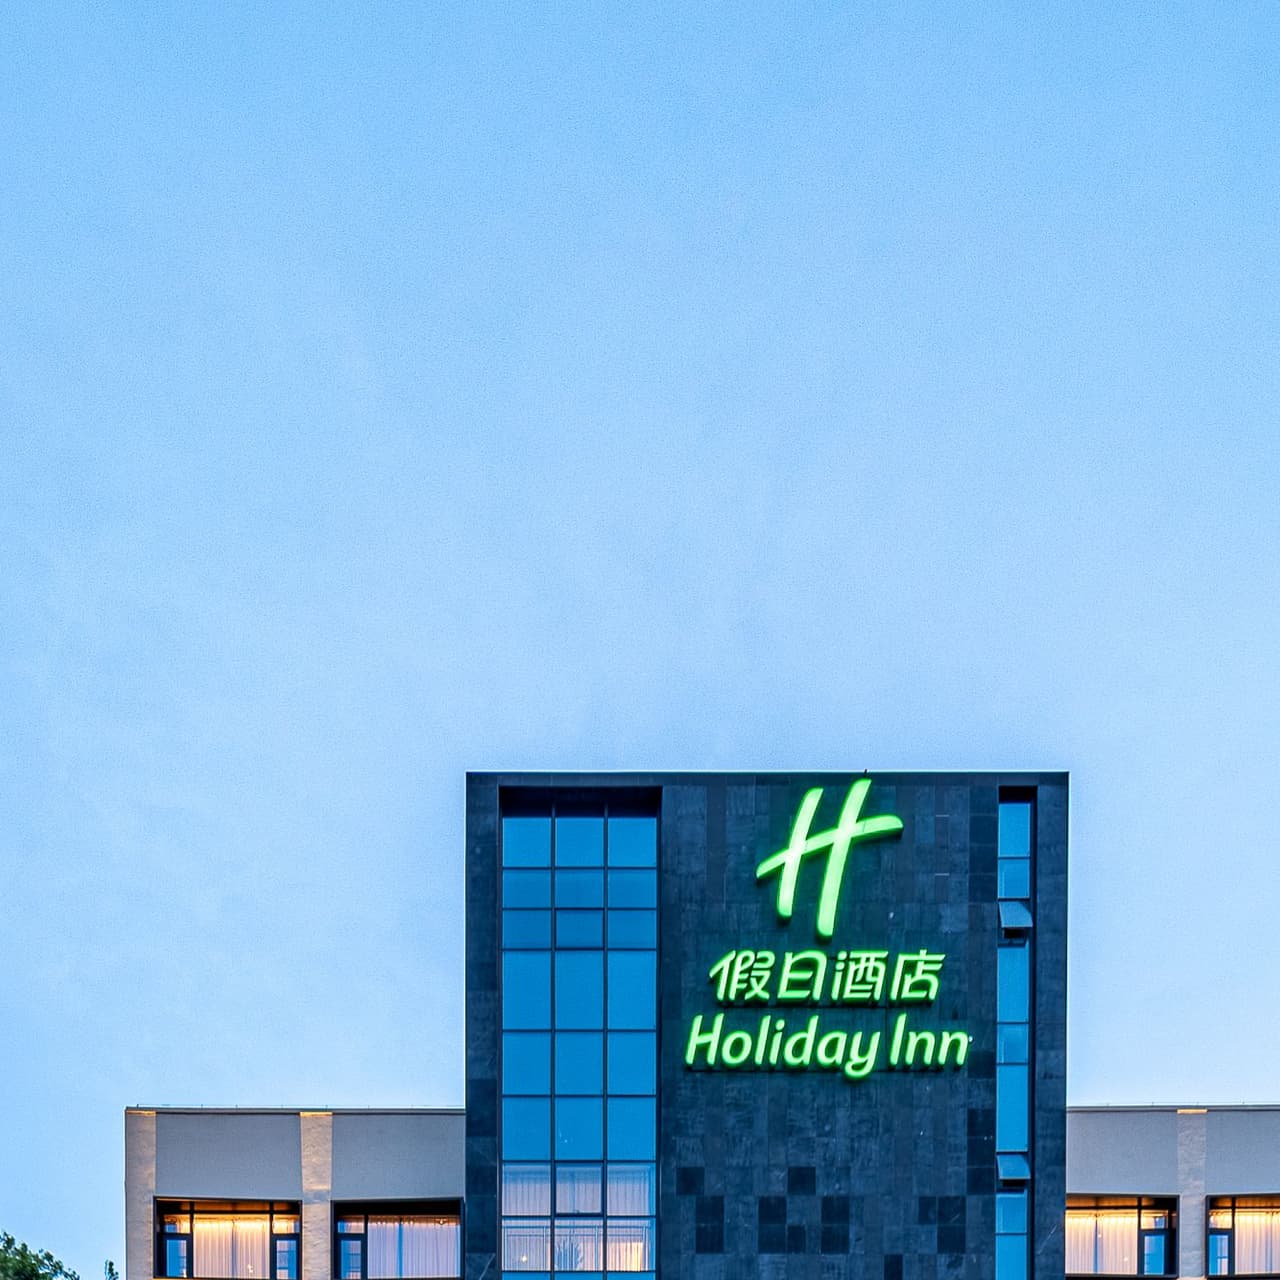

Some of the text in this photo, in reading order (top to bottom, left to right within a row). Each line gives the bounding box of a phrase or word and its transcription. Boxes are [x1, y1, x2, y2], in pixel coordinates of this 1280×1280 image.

[756, 778, 904, 938] H
[709, 949, 946, 1002] 假日酒店
[685, 1013, 970, 1078] Holiday Inn
